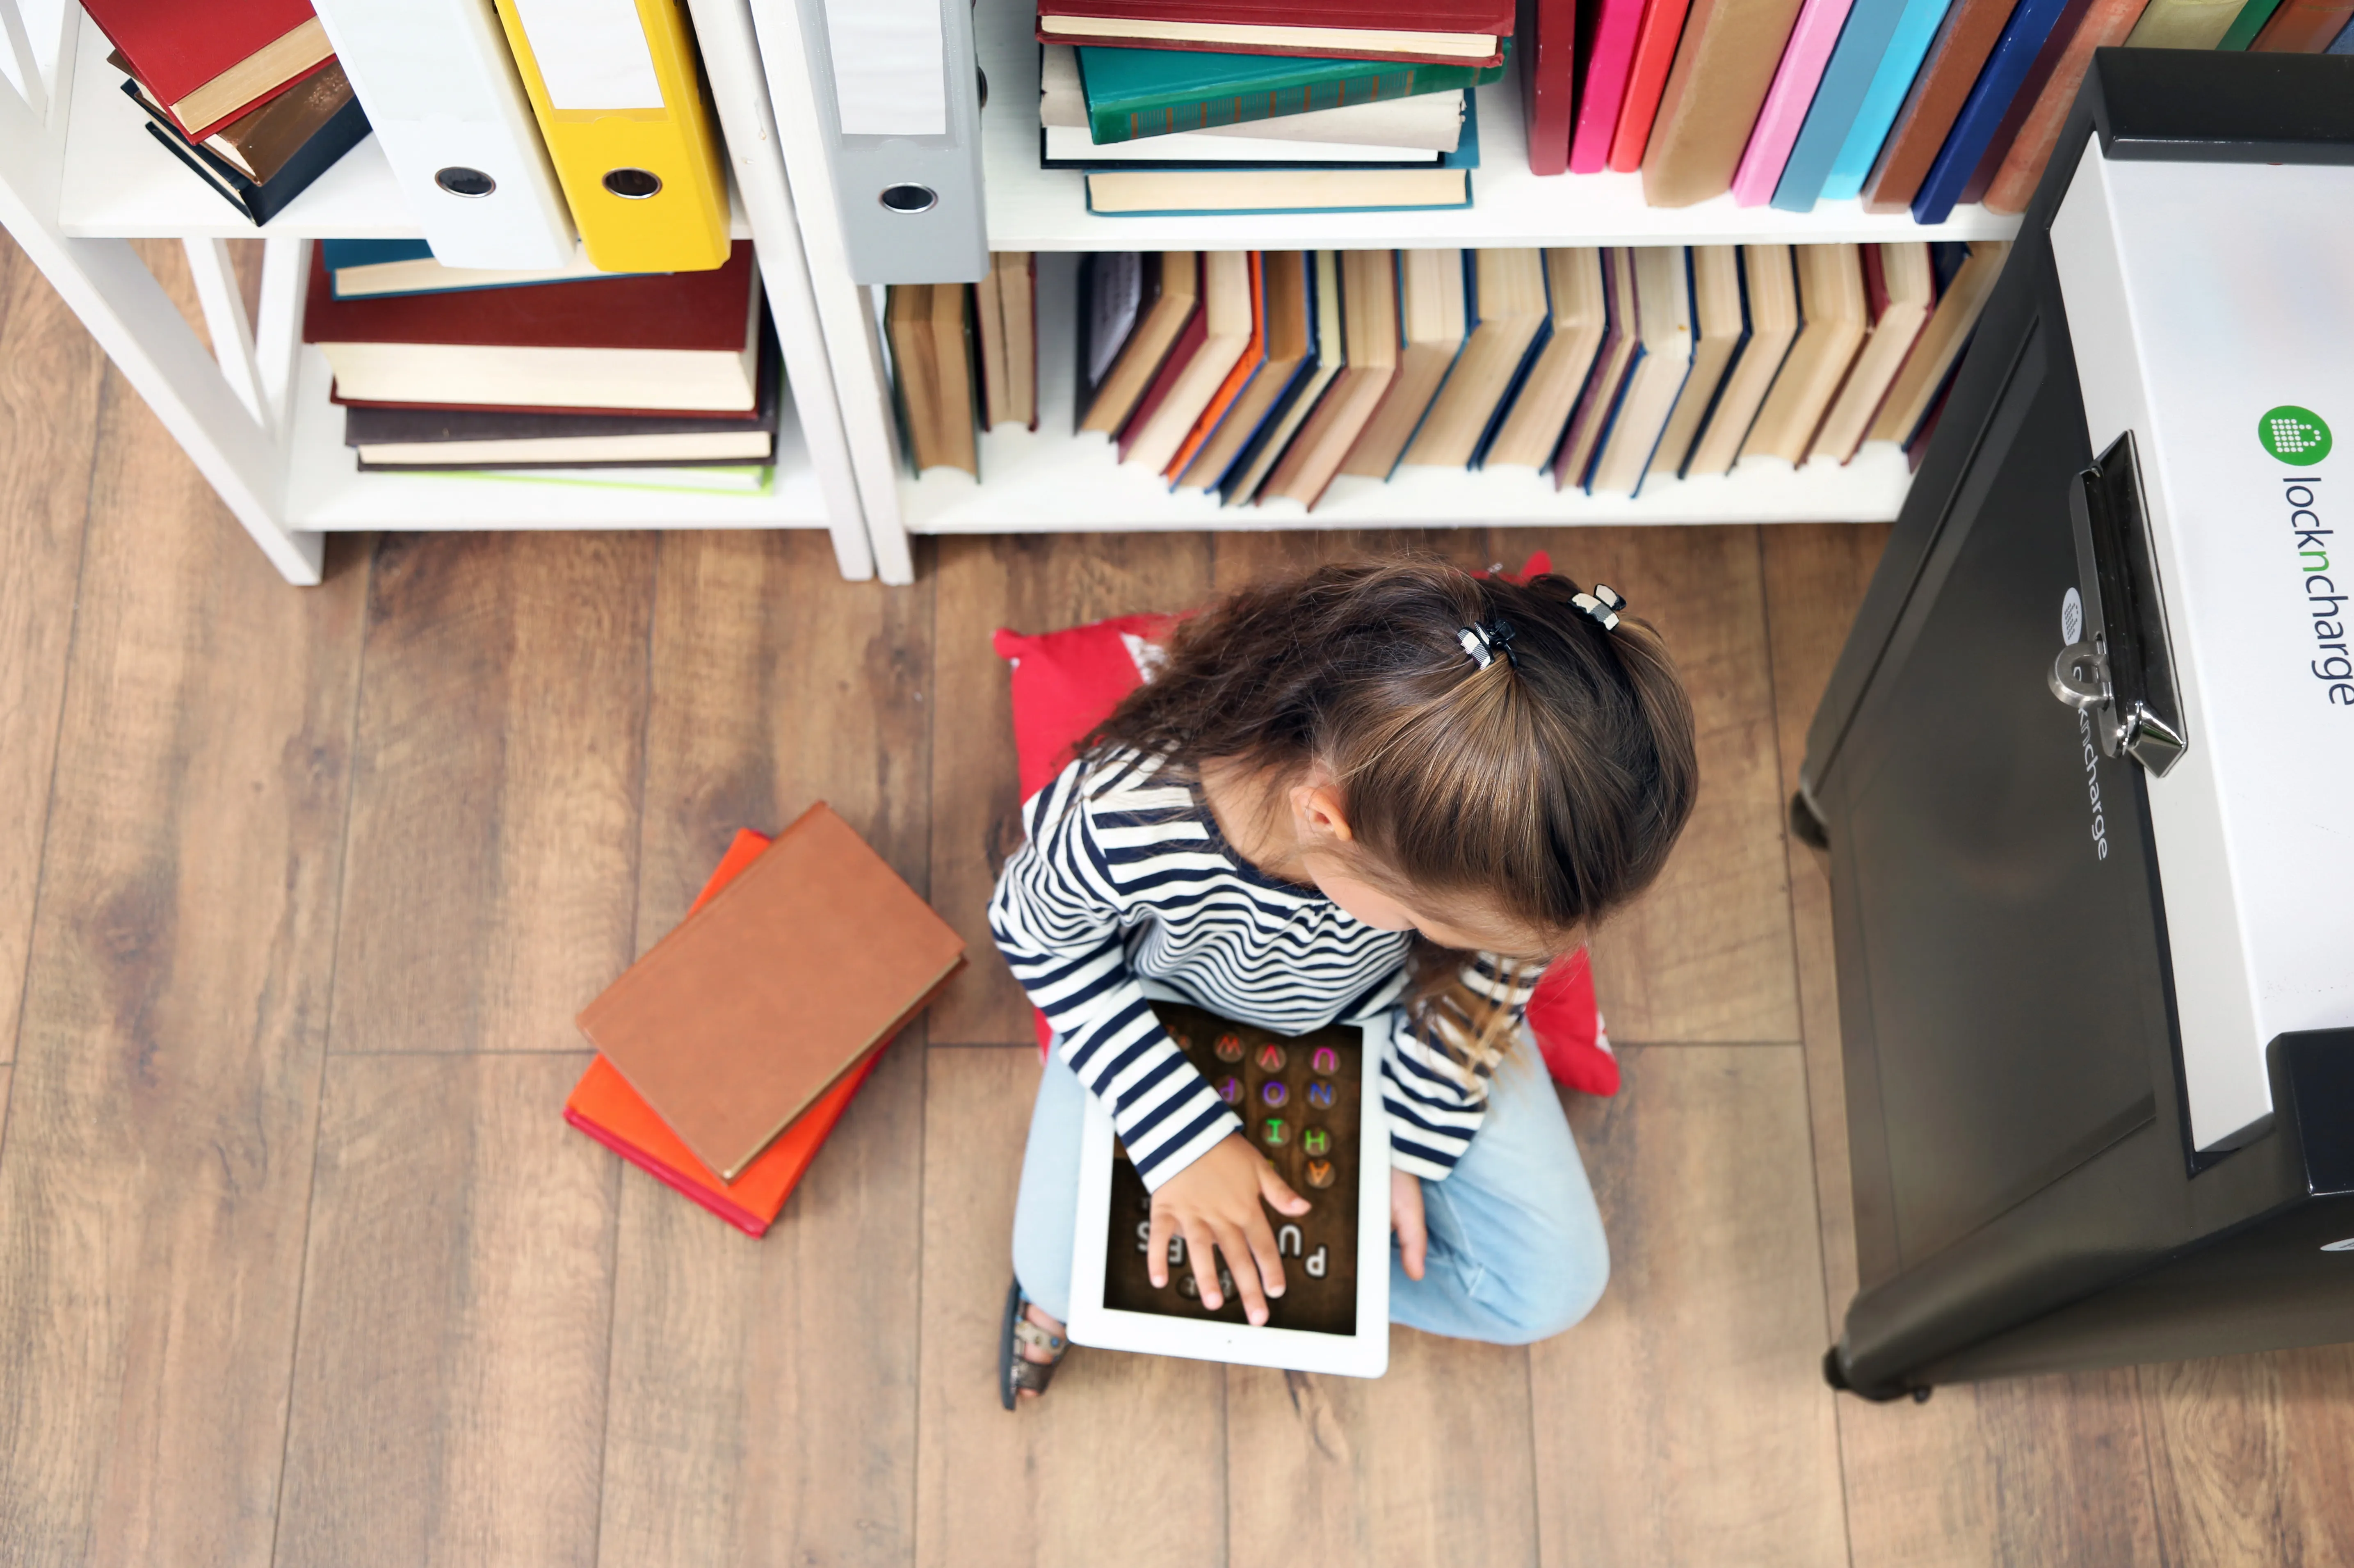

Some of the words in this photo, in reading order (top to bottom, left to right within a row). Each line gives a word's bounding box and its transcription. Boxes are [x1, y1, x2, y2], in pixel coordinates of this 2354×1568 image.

[2283, 477, 2354, 705] lockncharge
[1217, 1035, 1242, 1056] W
[1260, 1044, 1280, 1068] V
[1313, 1047, 1336, 1070] U
[1219, 1077, 1236, 1103] P
[1263, 1081, 1285, 1105] O
[1310, 1082, 1332, 1105] N
[1266, 1118, 1284, 1143] I
[1304, 1130, 1326, 1152] H
[1308, 1161, 1331, 1185] A
